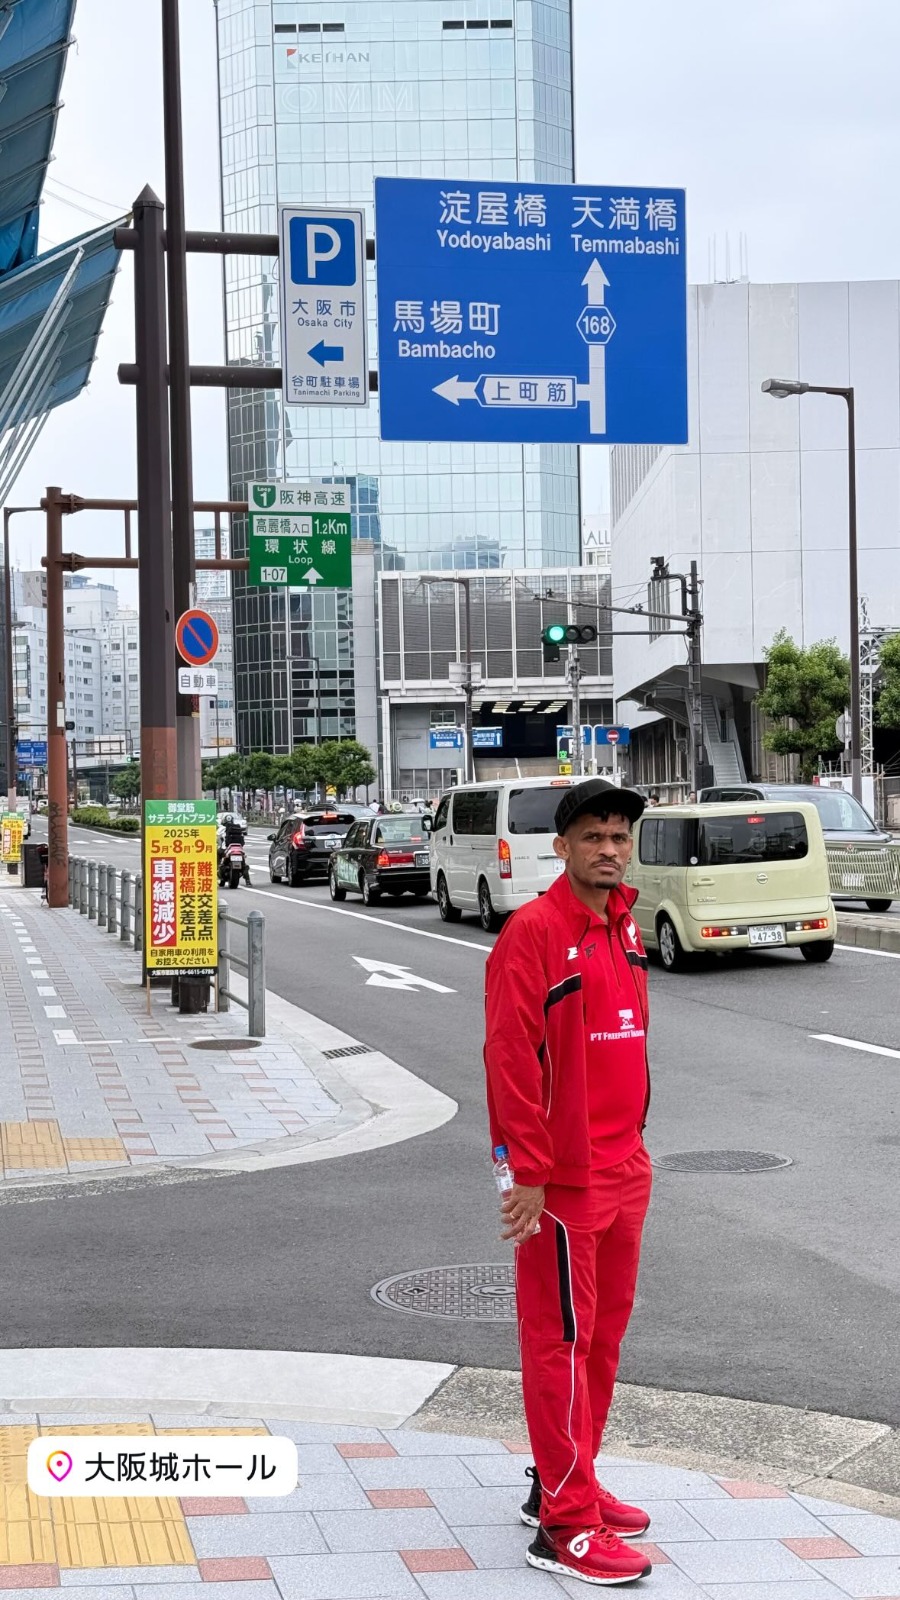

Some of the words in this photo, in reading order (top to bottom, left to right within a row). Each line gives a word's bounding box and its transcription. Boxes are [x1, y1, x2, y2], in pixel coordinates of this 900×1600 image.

[299, 51, 370, 63] KEIHAN
[282, 82, 414, 113] OMM
[439, 190, 547, 227] 淀屋橋
[571, 196, 677, 231] 天満橋
[437, 230, 551, 252] Yodoyabashi
[571, 234, 680, 255] Temmabashi
[306, 224, 341, 279] P
[292, 298, 356, 317] 大阪市
[297, 317, 328, 327] Osaka
[334, 318, 353, 329] City
[393, 300, 501, 336] 馬場町
[582, 316, 611, 335] 168
[398, 340, 496, 359] Bambacho
[292, 375, 360, 389] 谷町駐車場
[293, 388, 330, 396] Tanimachi
[334, 390, 360, 398] Parking
[491, 381, 567, 401] 上町筋
[260, 492, 268, 507] 1
[280, 490, 345, 506] 阪神高速
[256, 518, 310, 534] 高麗橋入口
[314, 519, 348, 535] 1.2Km
[264, 538, 337, 555] 環状線
[288, 555, 313, 565] Loop
[262, 568, 286, 581] 1-07
[180, 674, 216, 688] 自動車
[167, 802, 195, 813] 御堂筋
[148, 813, 215, 823] サテライトプラン
[163, 828, 200, 838] 2025年
[152, 858, 175, 945] 車線減少
[179, 861, 196, 941] 新橋交差点
[197, 861, 213, 941] 難波交差点
[150, 948, 214, 957] 自家用車の利用を
[155, 957, 210, 966] お控えください
[590, 1032, 602, 1042] PT
